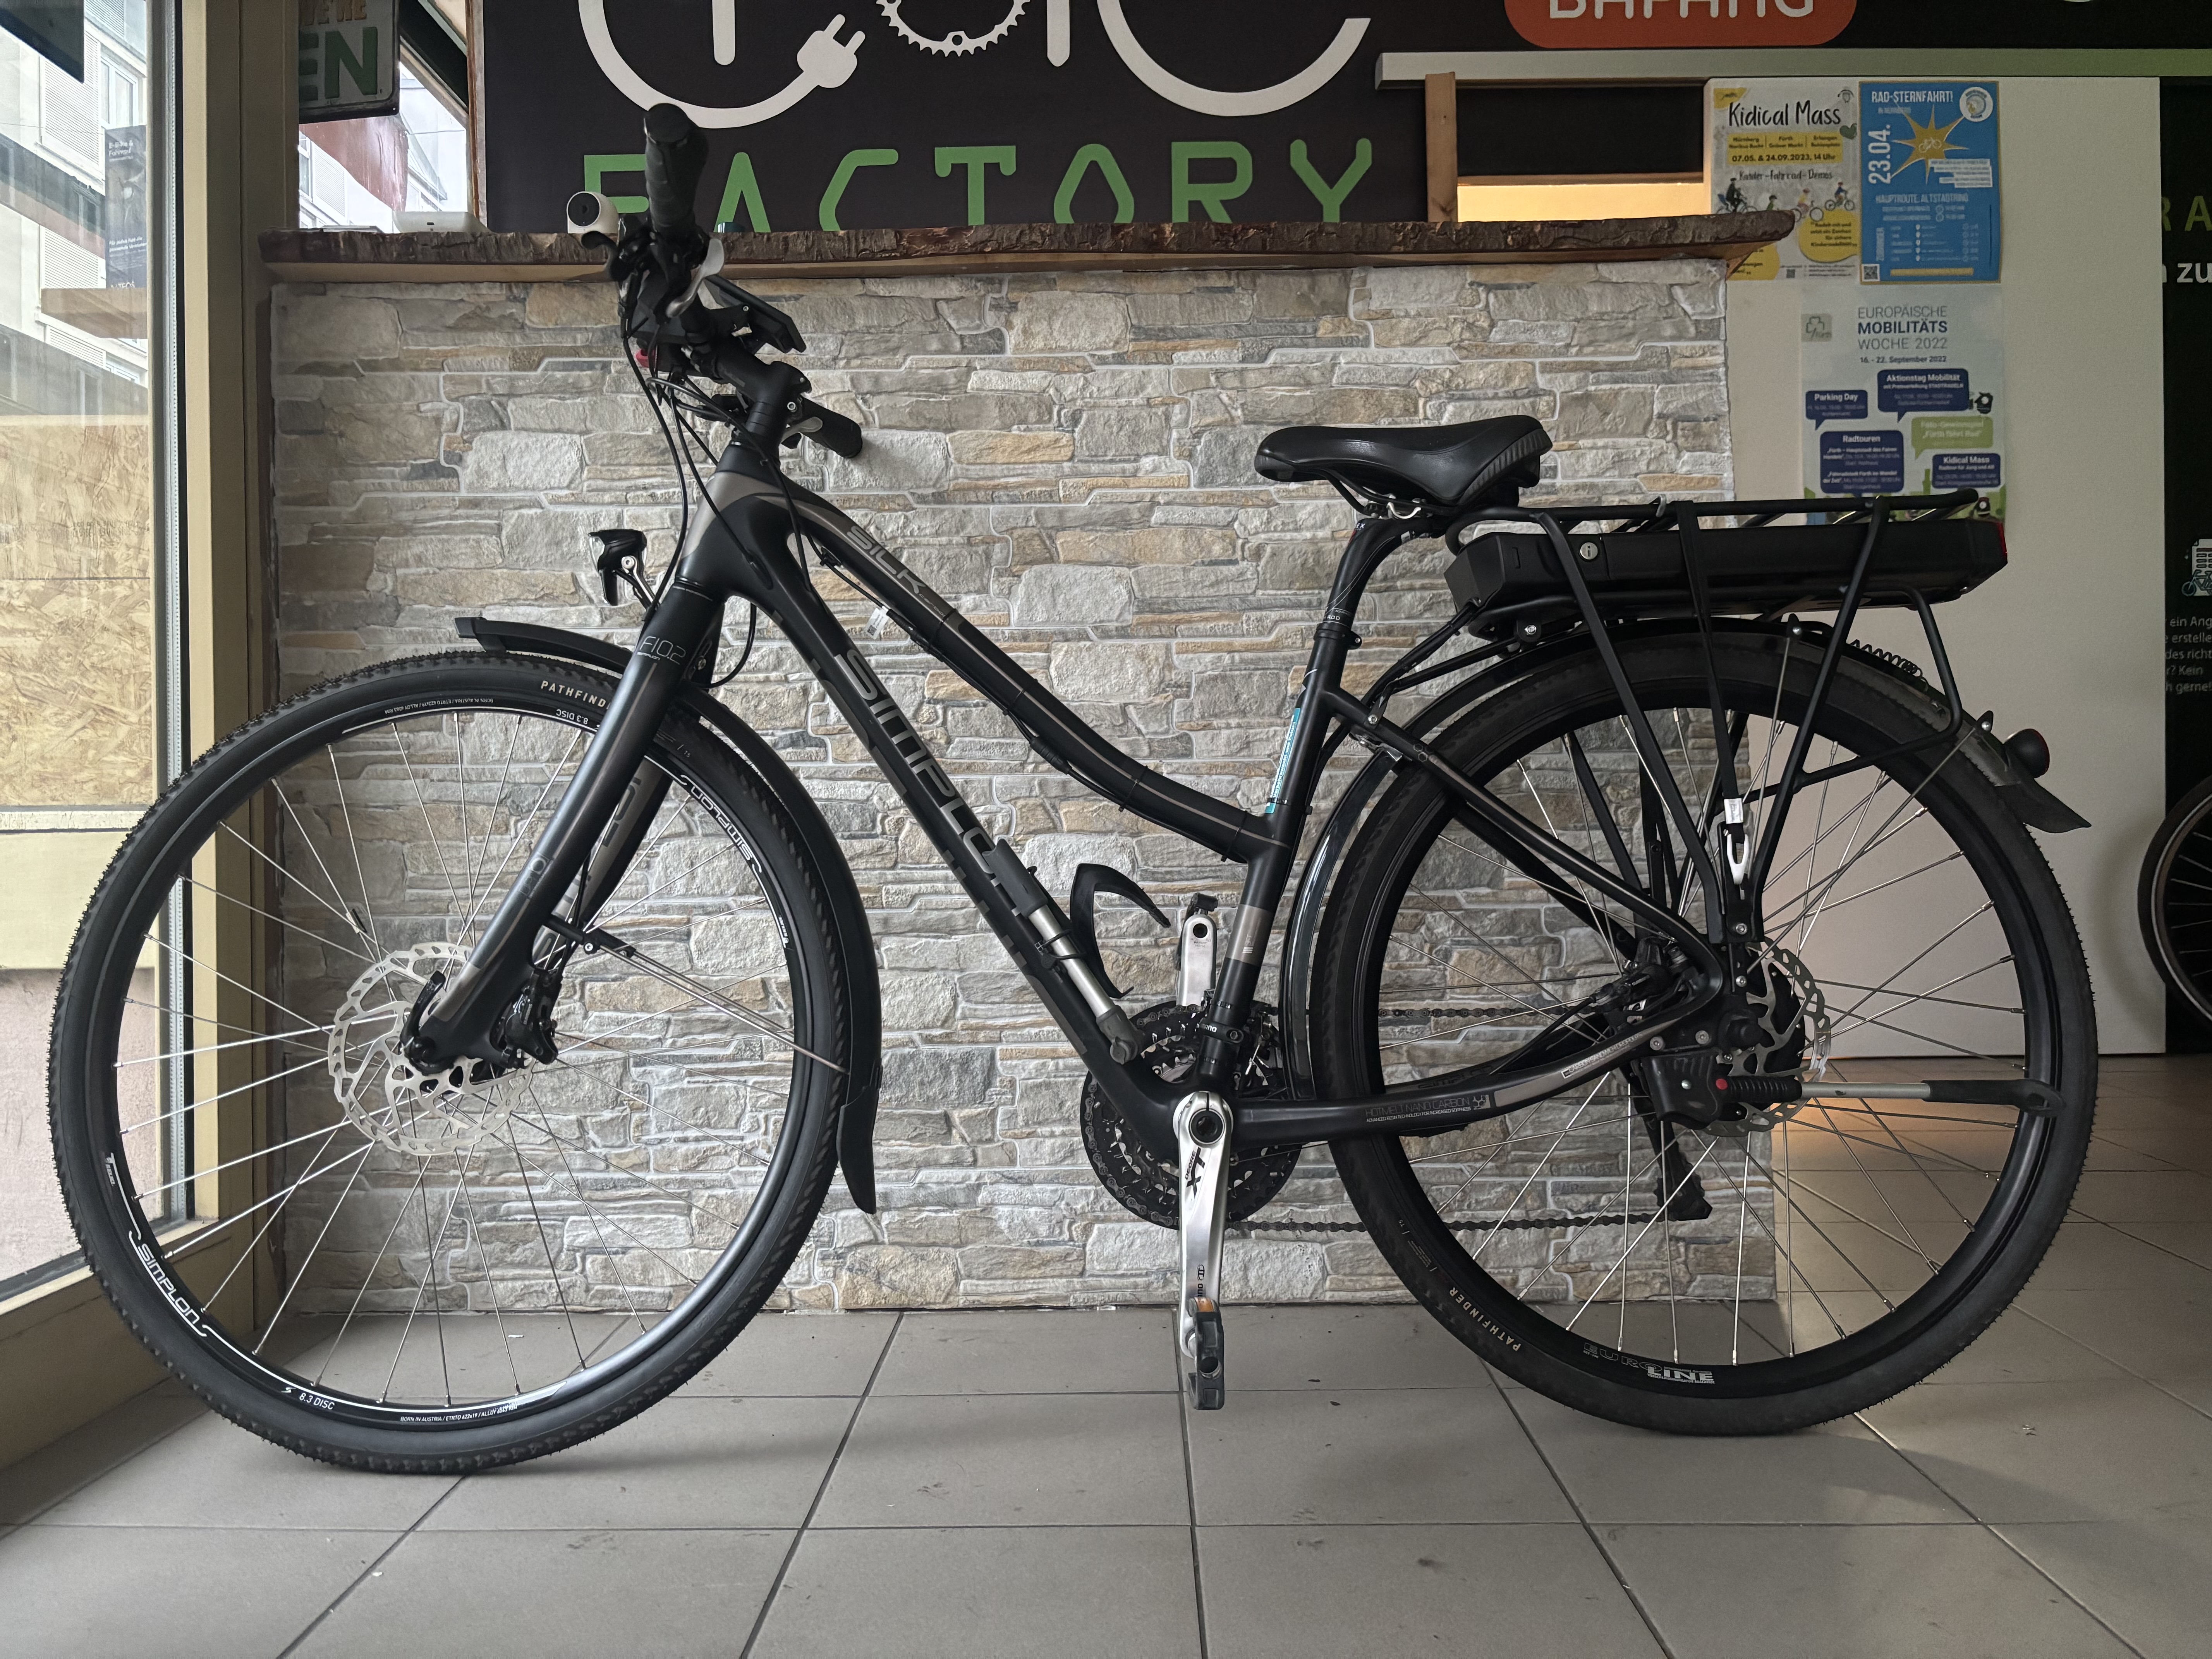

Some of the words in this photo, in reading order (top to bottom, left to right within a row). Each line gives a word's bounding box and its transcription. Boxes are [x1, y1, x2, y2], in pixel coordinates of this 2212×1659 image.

[1729, 102, 1788, 127] Kidical
[1796, 100, 1841, 125] Mass
[1868, 124, 1891, 184] 23.04.
[584, 137, 1372, 231] FACTORY
[1858, 306, 1947, 319] EUROPÄISCHE
[1858, 320, 1948, 334] MOBILITÄTS
[1858, 338, 1909, 349] WOCHE
[1915, 337, 1947, 349] 2022
[1887, 374, 1926, 383] Aktionstag
[1814, 393, 1843, 402] Parking
[1844, 393, 1858, 402] Day
[846, 525, 926, 594] SILK
[2170, 618, 2186, 627] ein
[2179, 666, 2203, 675] Kein
[556, 709, 575, 720] DISC
[577, 715, 589, 725] 8.3
[835, 649, 1022, 916] SIMPLO
[690, 786, 754, 861] SIMPLON
[1406, 1101, 1431, 1112] NANO
[1433, 1097, 1470, 1109] CARBON
[1185, 1149, 1196, 1180] DEORE
[1186, 1147, 1206, 1199] XT
[137, 1243, 200, 1325] SIMPLON
[1449, 1287, 1522, 1352] PATHFINDER
[1584, 1343, 1662, 1372] EURO
[1647, 1366, 1714, 1381] LINE
[299, 1393, 313, 1403] 8.3
[314, 1397, 335, 1410] DISC
